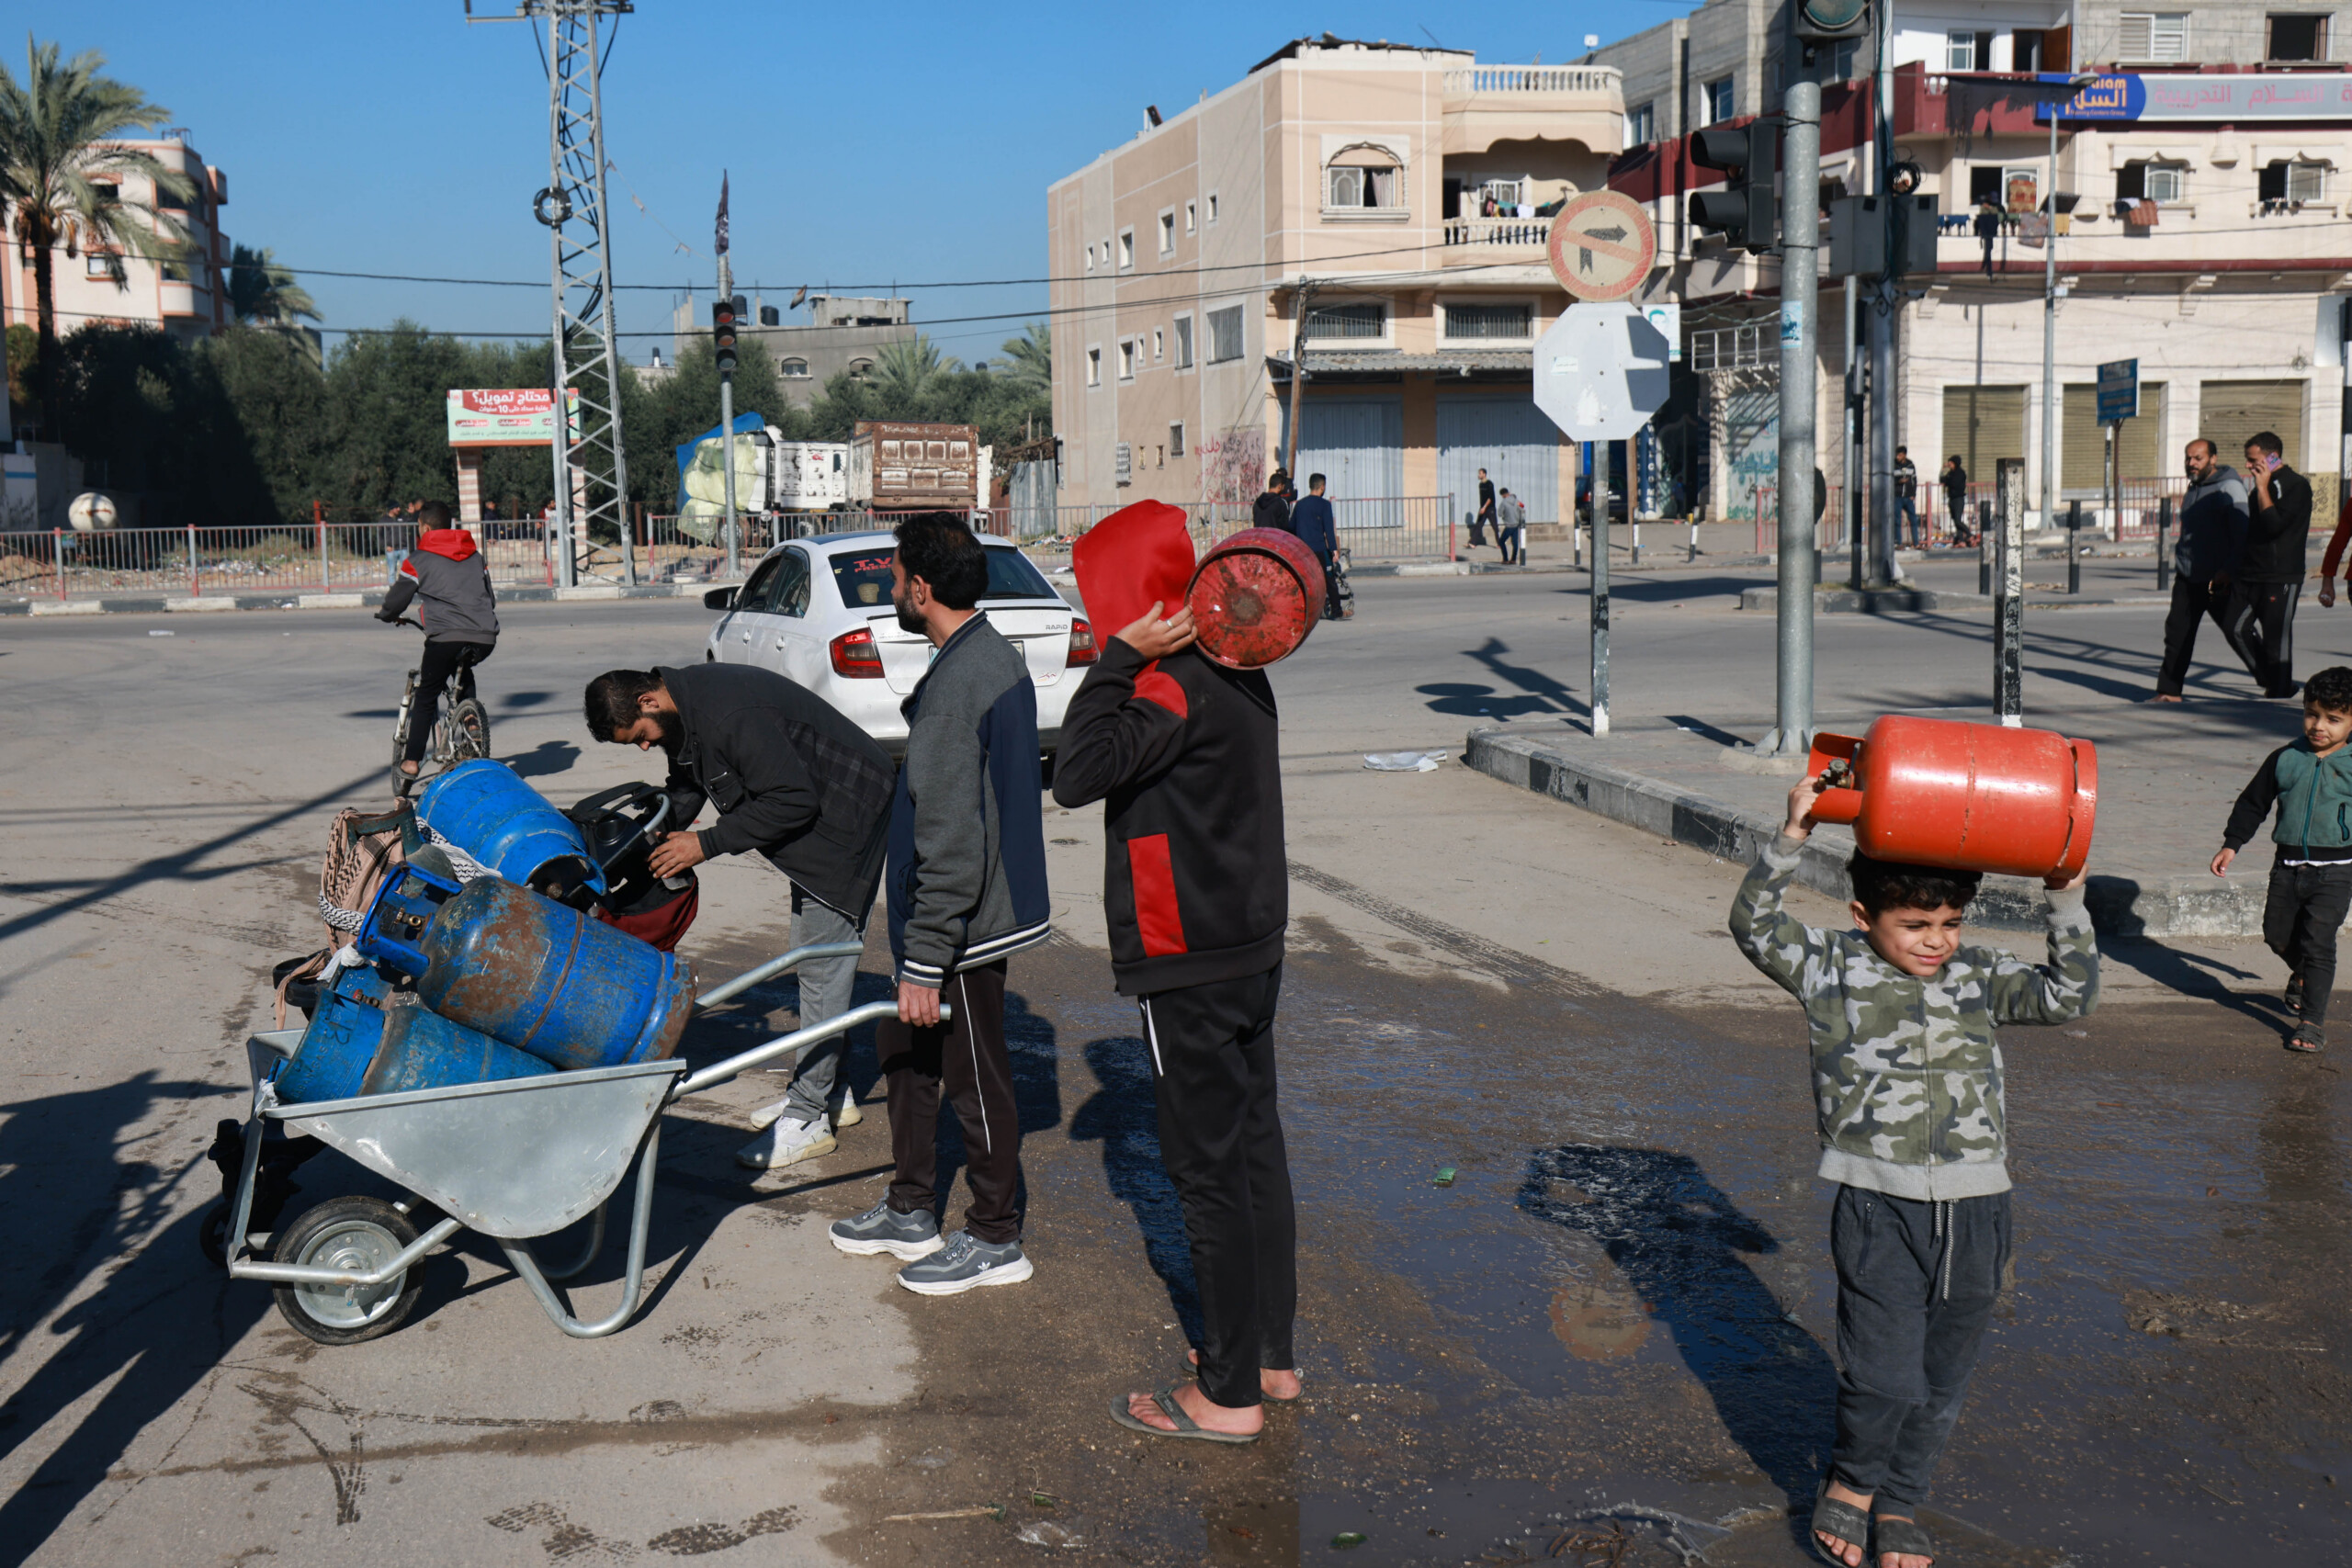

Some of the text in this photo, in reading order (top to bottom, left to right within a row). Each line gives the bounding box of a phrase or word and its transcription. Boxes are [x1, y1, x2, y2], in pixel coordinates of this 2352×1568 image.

[472, 390, 550, 405] محتاج تمويل؟
[498, 405, 508, 413] 10
